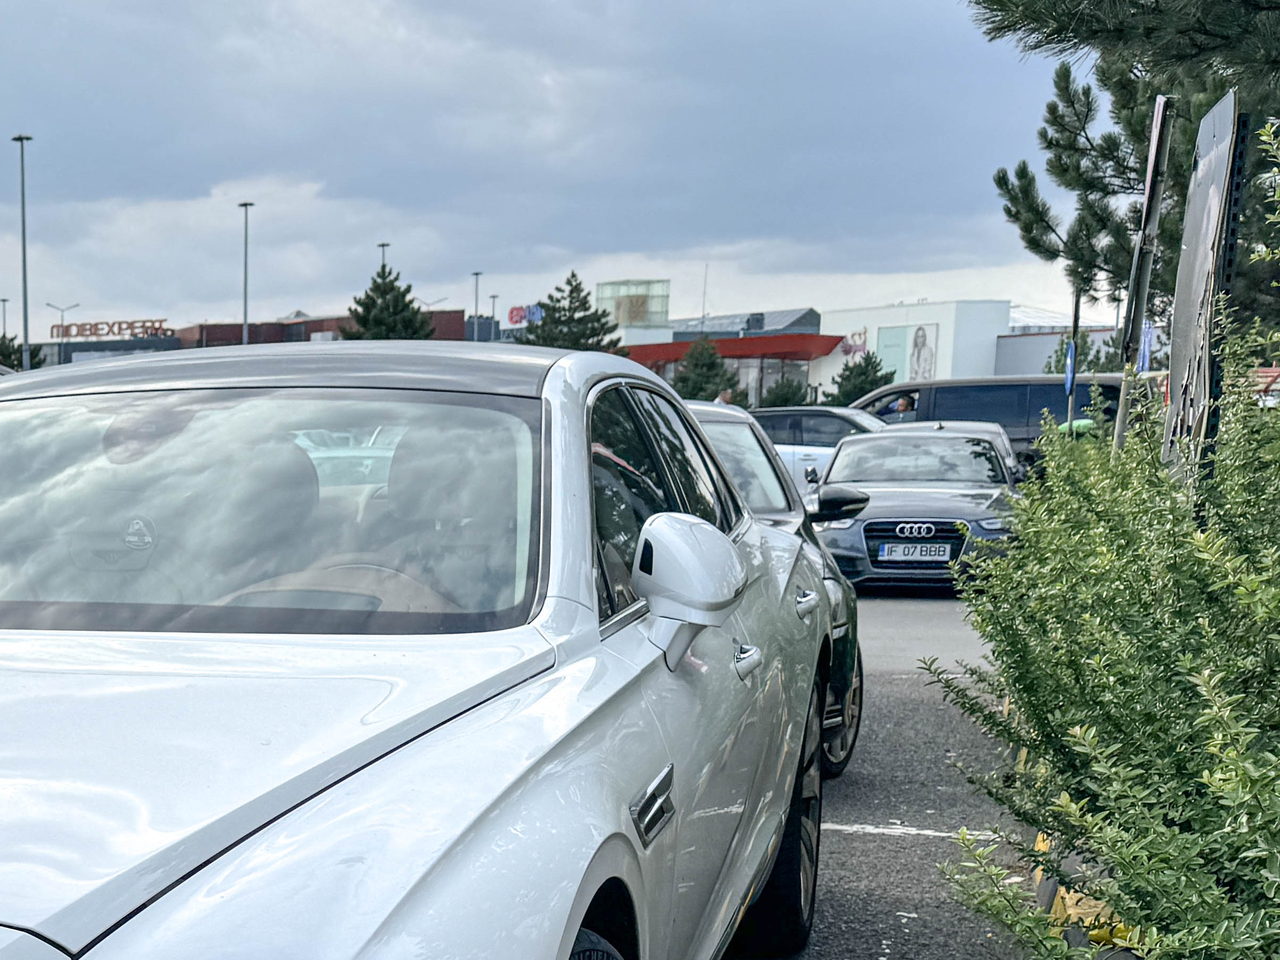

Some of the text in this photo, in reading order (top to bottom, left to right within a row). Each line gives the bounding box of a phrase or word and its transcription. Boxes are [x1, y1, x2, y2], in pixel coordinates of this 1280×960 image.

[50, 319, 168, 339] MOBEXPERT
[886, 545, 898, 556] IF
[902, 545, 917, 556] 07
[919, 545, 946, 556] BBB
